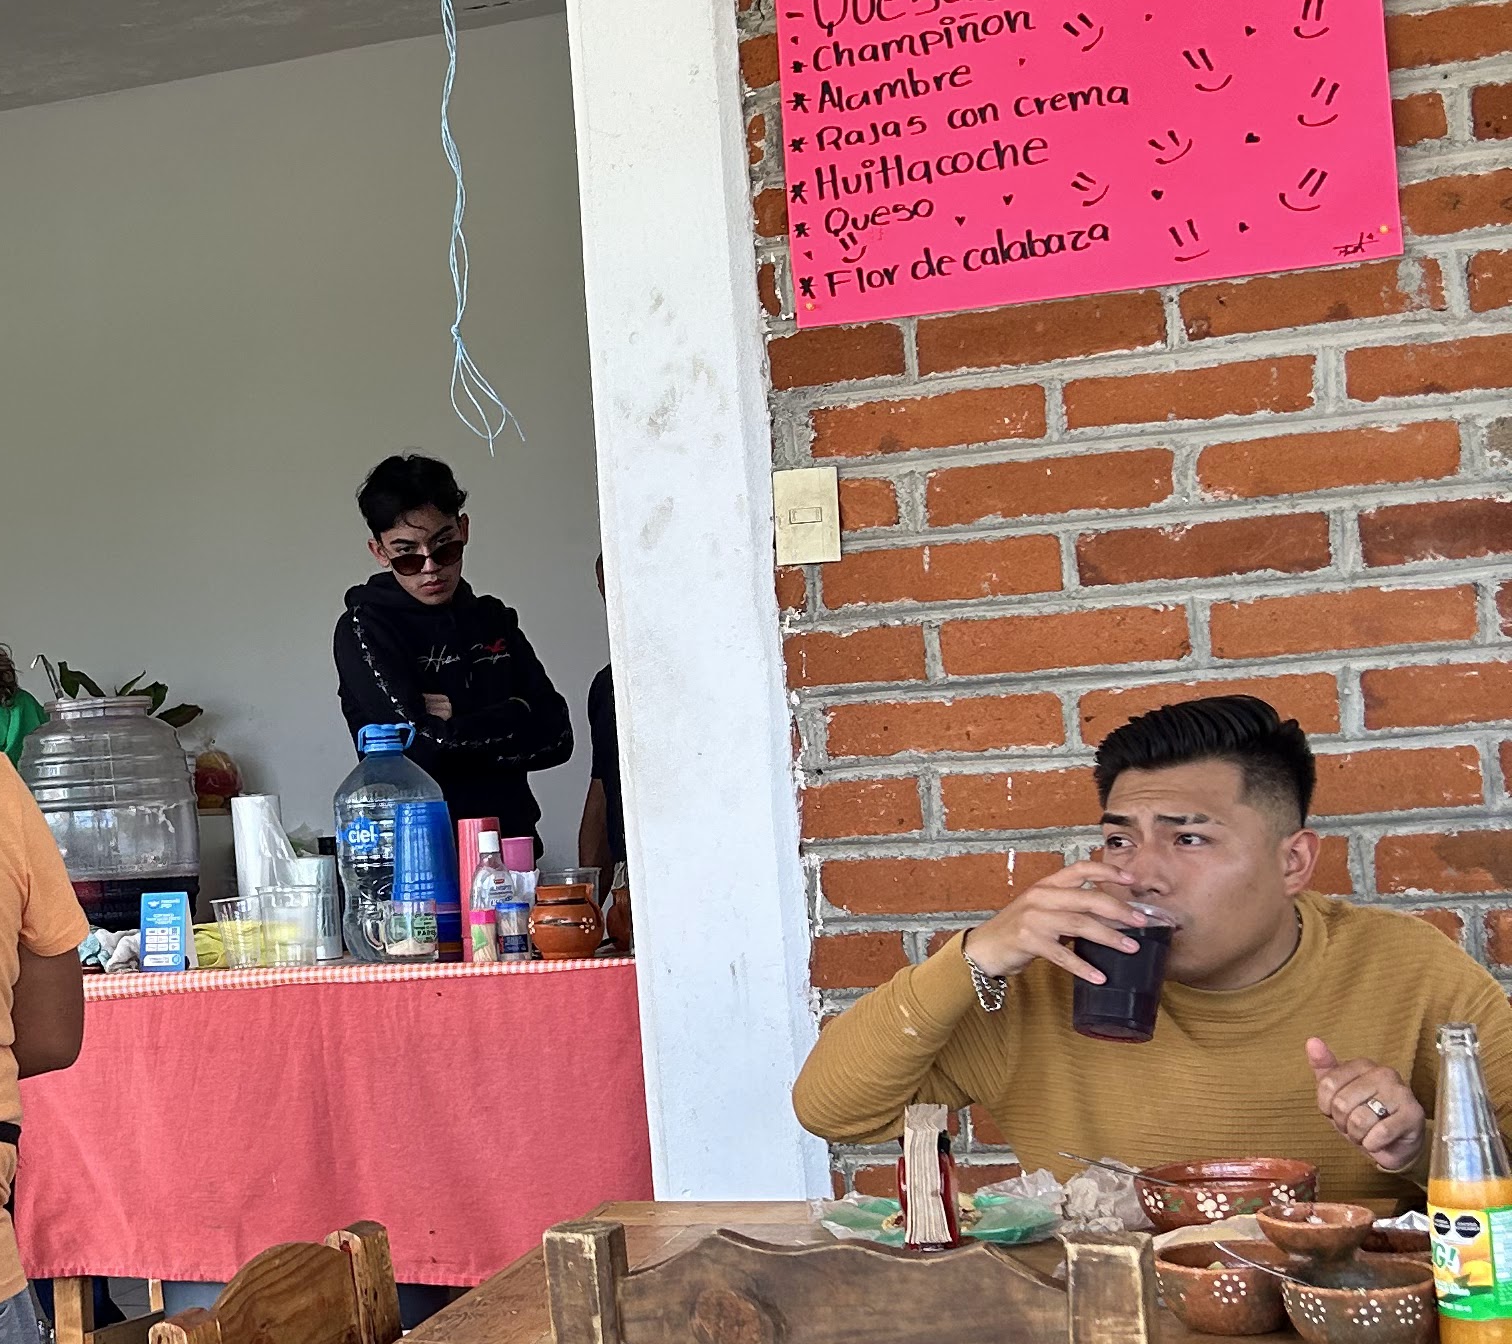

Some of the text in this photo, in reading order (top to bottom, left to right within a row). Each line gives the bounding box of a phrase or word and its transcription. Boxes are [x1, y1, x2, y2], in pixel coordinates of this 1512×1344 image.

[818, 65, 973, 113] Alambre
[816, 86, 1130, 152] Rajas con crema
[815, 137, 1049, 201] Huitlacoche
[825, 199, 935, 237] Queso
[824, 223, 1110, 297] Flor de calabaza
[348, 823, 375, 844] ciel
